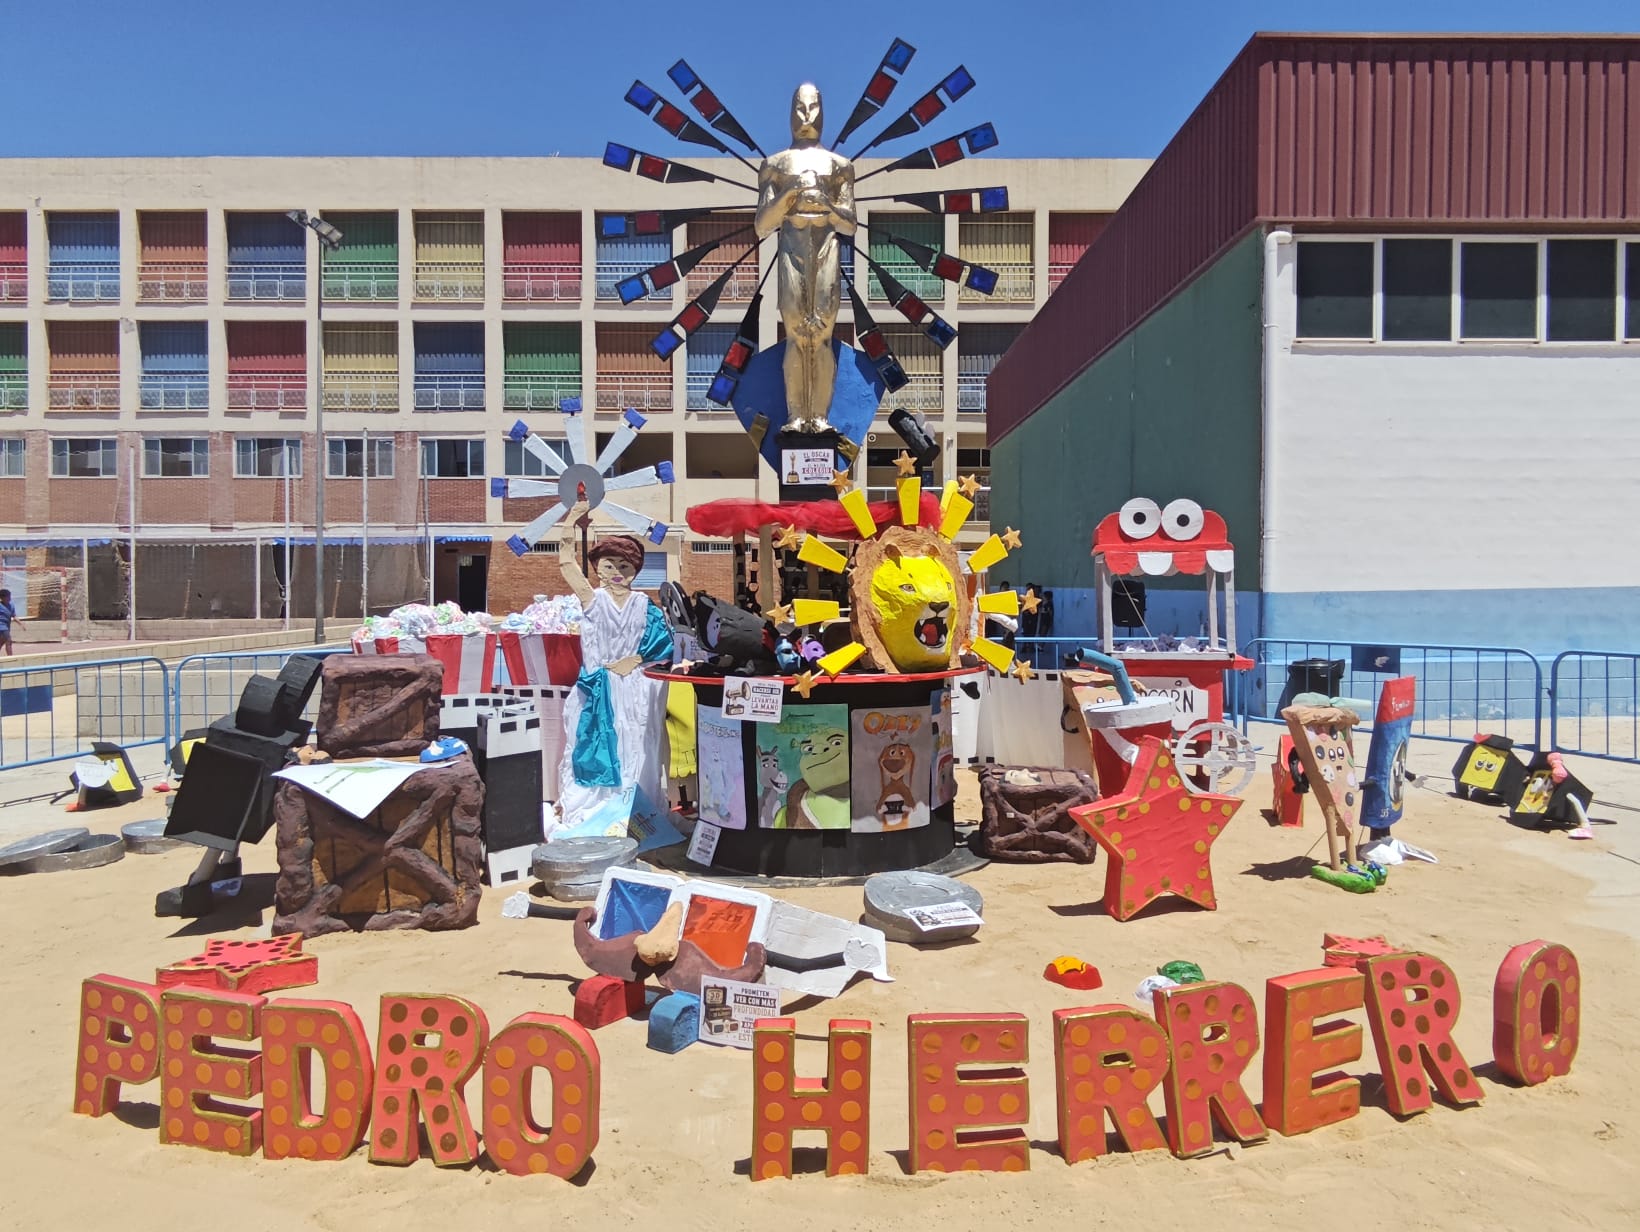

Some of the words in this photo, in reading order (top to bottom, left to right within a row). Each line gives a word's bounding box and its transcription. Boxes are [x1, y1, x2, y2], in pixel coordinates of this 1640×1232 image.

[741, 987, 770, 997] PROMETEN
[735, 995, 747, 1004] VER
[747, 997, 760, 1005] CON
[733, 1005, 776, 1016] PROFUNDIDAD
[74, 973, 600, 1181] PEDRO
[751, 940, 1580, 1181] HERRERO
